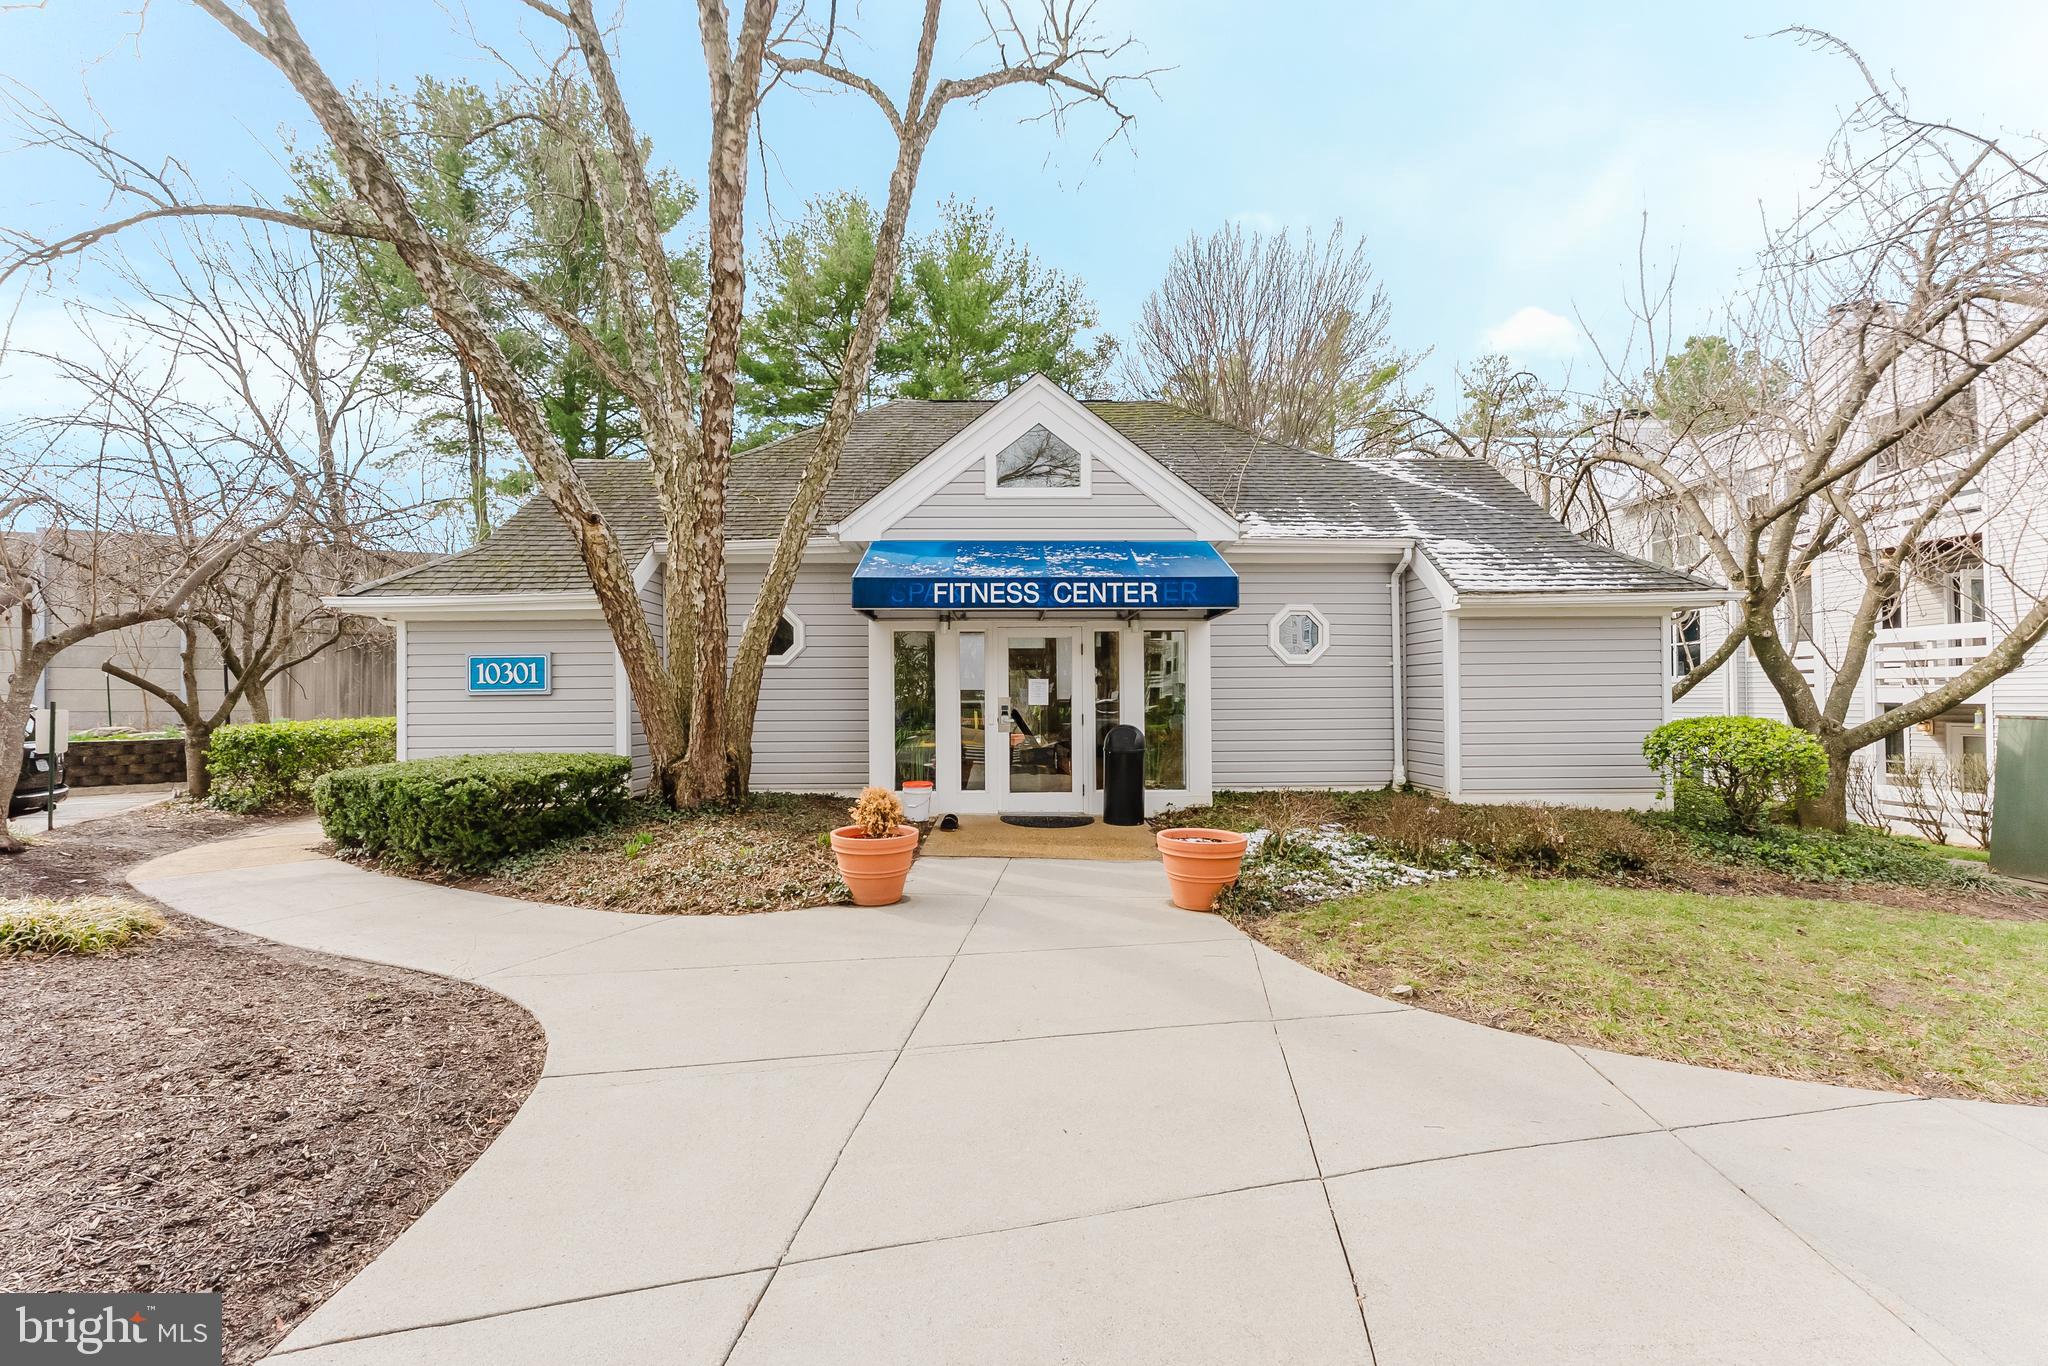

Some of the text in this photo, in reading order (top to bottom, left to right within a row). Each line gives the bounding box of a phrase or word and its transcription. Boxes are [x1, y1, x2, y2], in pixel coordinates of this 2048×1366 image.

[933, 582, 1040, 604] FITNESS
[1053, 582, 1158, 604] CENTER
[476, 662, 539, 685] 10301
